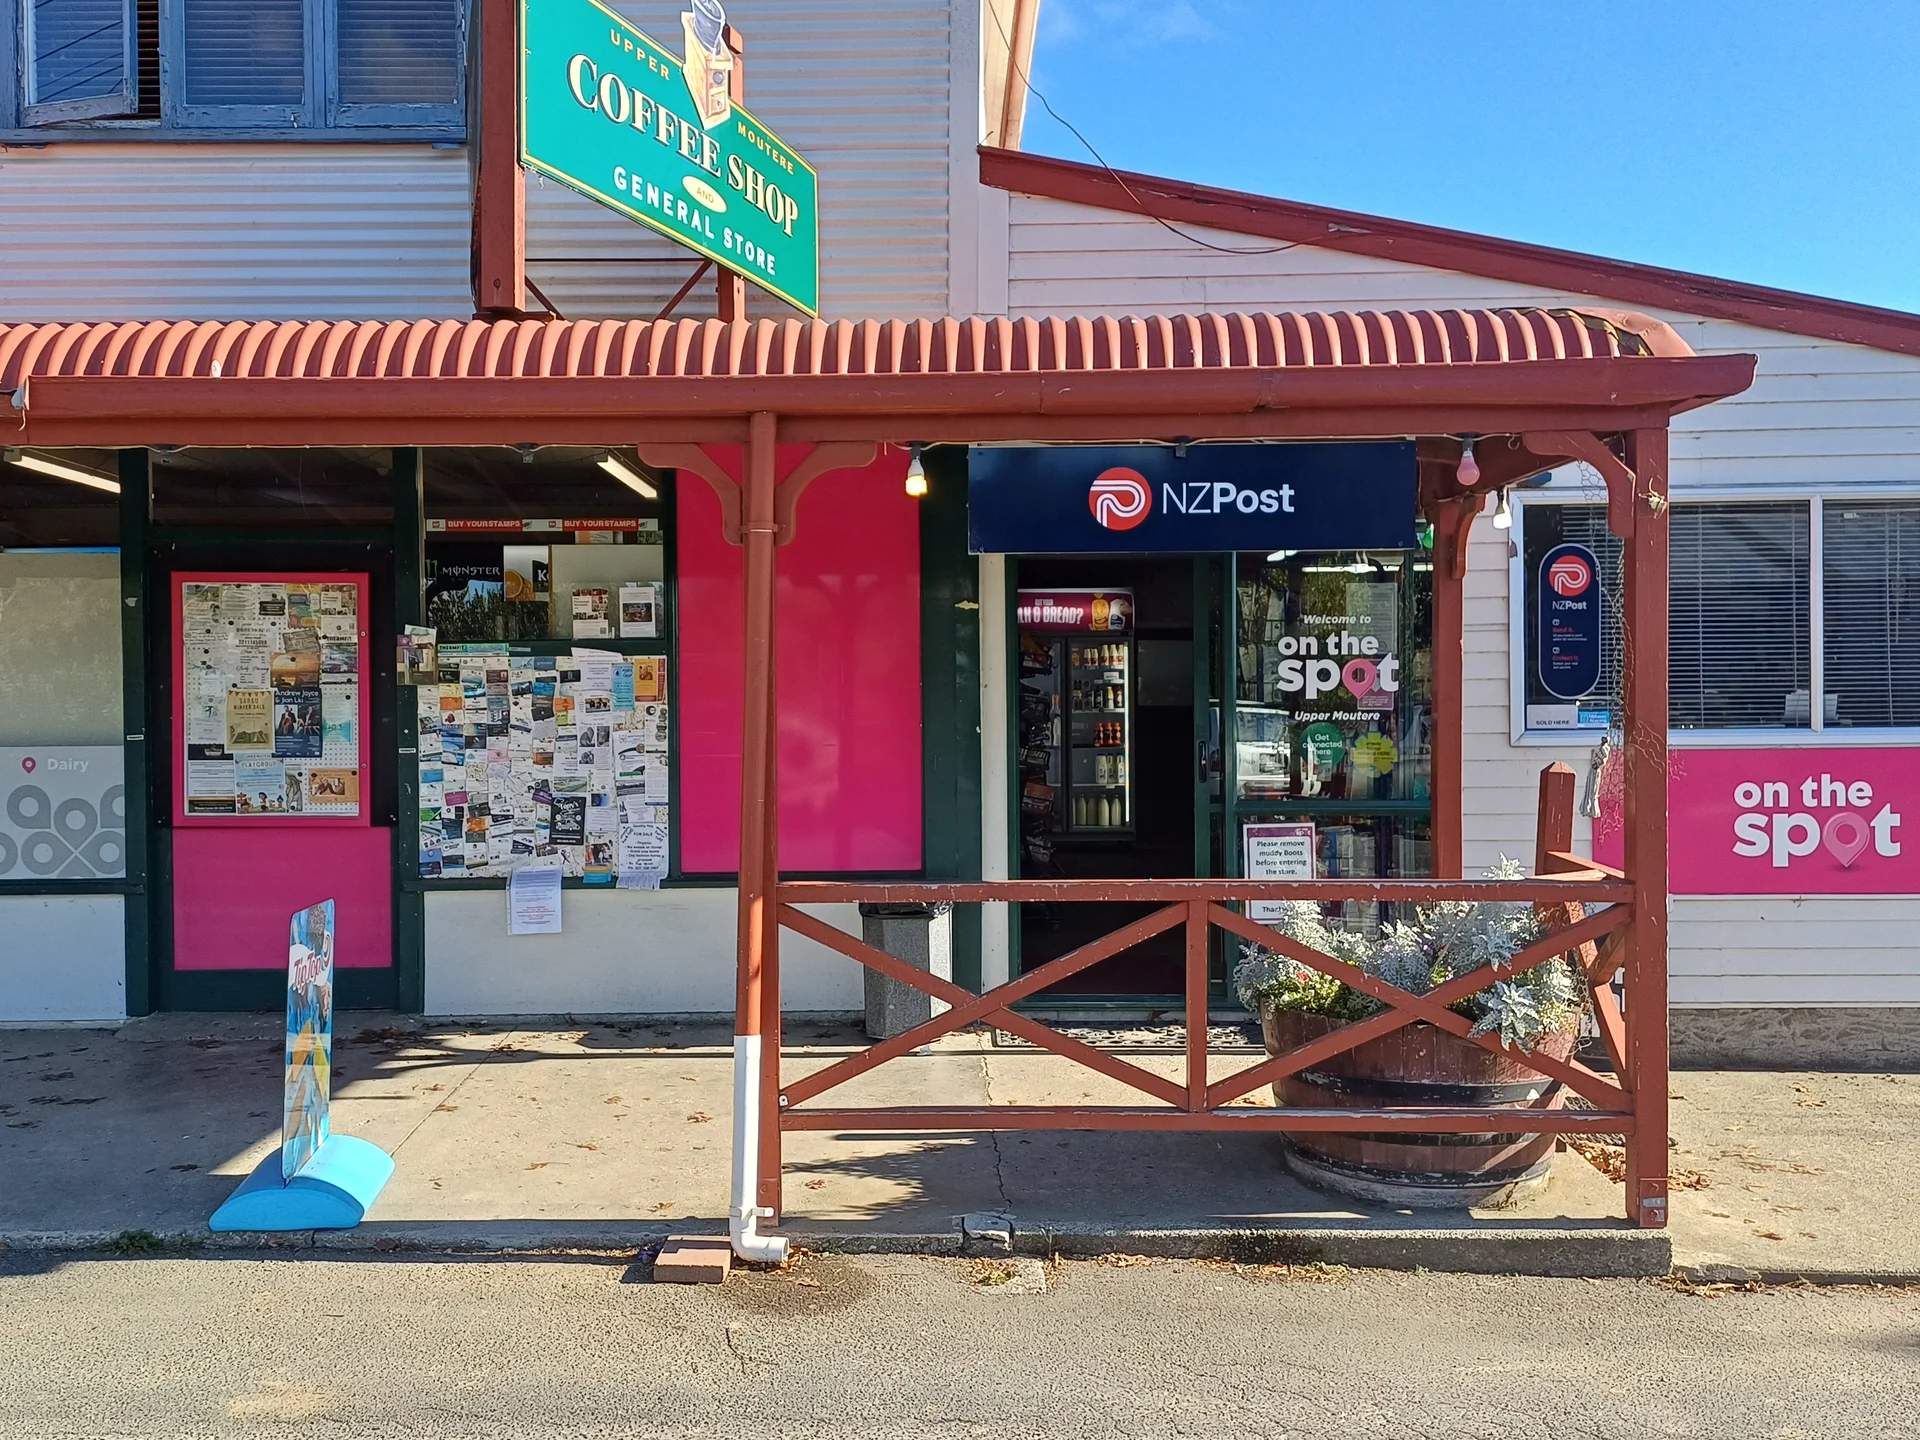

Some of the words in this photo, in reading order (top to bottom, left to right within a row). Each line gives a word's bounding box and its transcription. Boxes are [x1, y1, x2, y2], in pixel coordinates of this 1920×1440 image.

[610, 29, 669, 80] UPPER
[567, 54, 721, 178] COFFEE
[728, 154, 798, 237] SHOP
[738, 121, 794, 175] MOUTERE
[696, 187, 714, 203] AND
[613, 166, 714, 239] GENERAL
[723, 227, 776, 275] STORE
[1163, 482, 1295, 514] NZPost
[1043, 606, 1084, 624] BREAD?
[1303, 614, 1357, 624] Welcome
[1360, 614, 1371, 624] to
[1552, 600, 1587, 610] NZPost
[1278, 636, 1318, 655] on
[1326, 630, 1379, 655] the
[1277, 652, 1399, 699] spot
[1294, 711, 1330, 722] Upper
[1332, 711, 1380, 720] Moutere
[47, 758, 89, 772] Dairy
[1734, 781, 1789, 808] on
[1800, 774, 1873, 807] the
[1732, 803, 1901, 867] spot
[294, 957, 307, 995] Tip
[307, 952, 321, 984] Top
